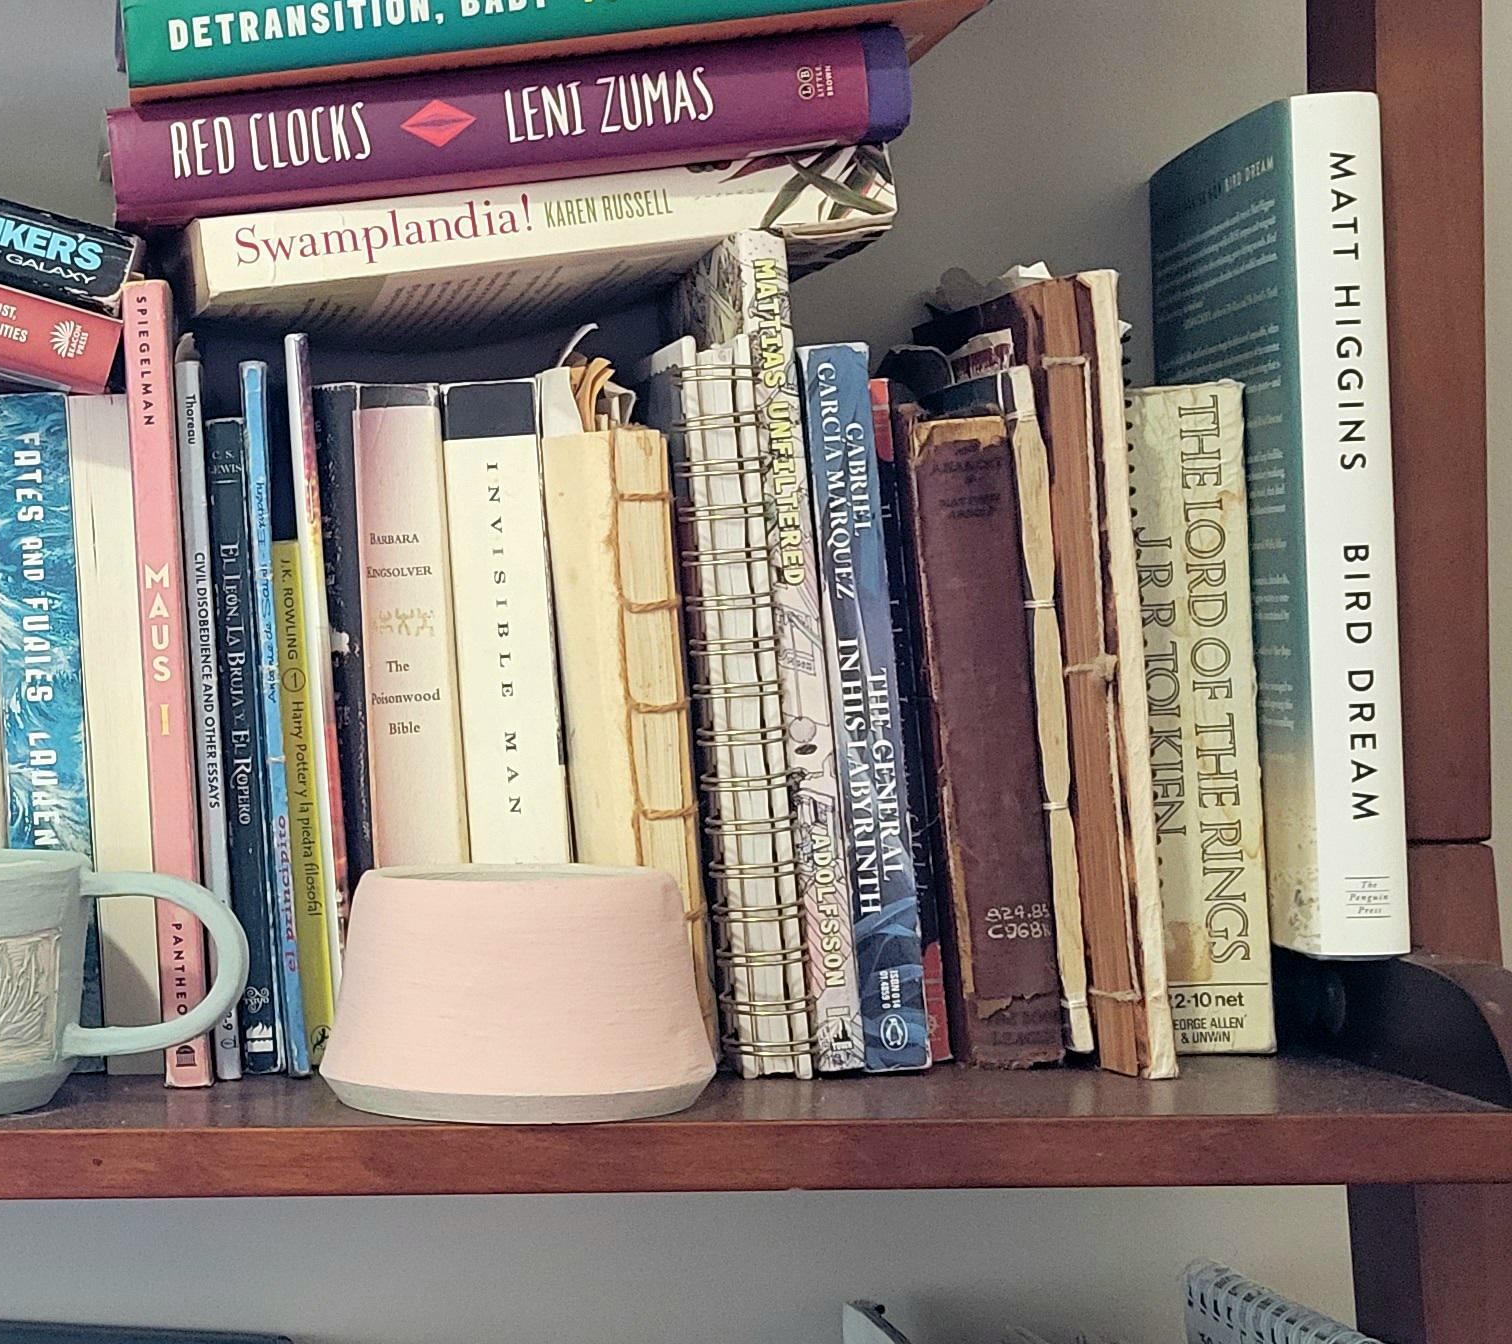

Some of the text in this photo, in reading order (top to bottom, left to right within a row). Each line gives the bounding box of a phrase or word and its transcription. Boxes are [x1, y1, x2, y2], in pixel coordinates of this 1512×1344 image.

[170, 68, 715, 179] RED CLOCKS LENI ZUMAS
[235, 189, 673, 267] Swamplandia! KAREN RUSSELL
[136, 296, 155, 427] SPIEGELMAN
[185, 393, 199, 444] Thoreau
[817, 361, 860, 600] GARCÍA MÁRQUEZ
[847, 422, 871, 537] GABRIEL
[1330, 151, 1379, 822] MATT HIGGINS BIRD DREAM
[486, 463, 523, 815] INVISIBLE MAN
